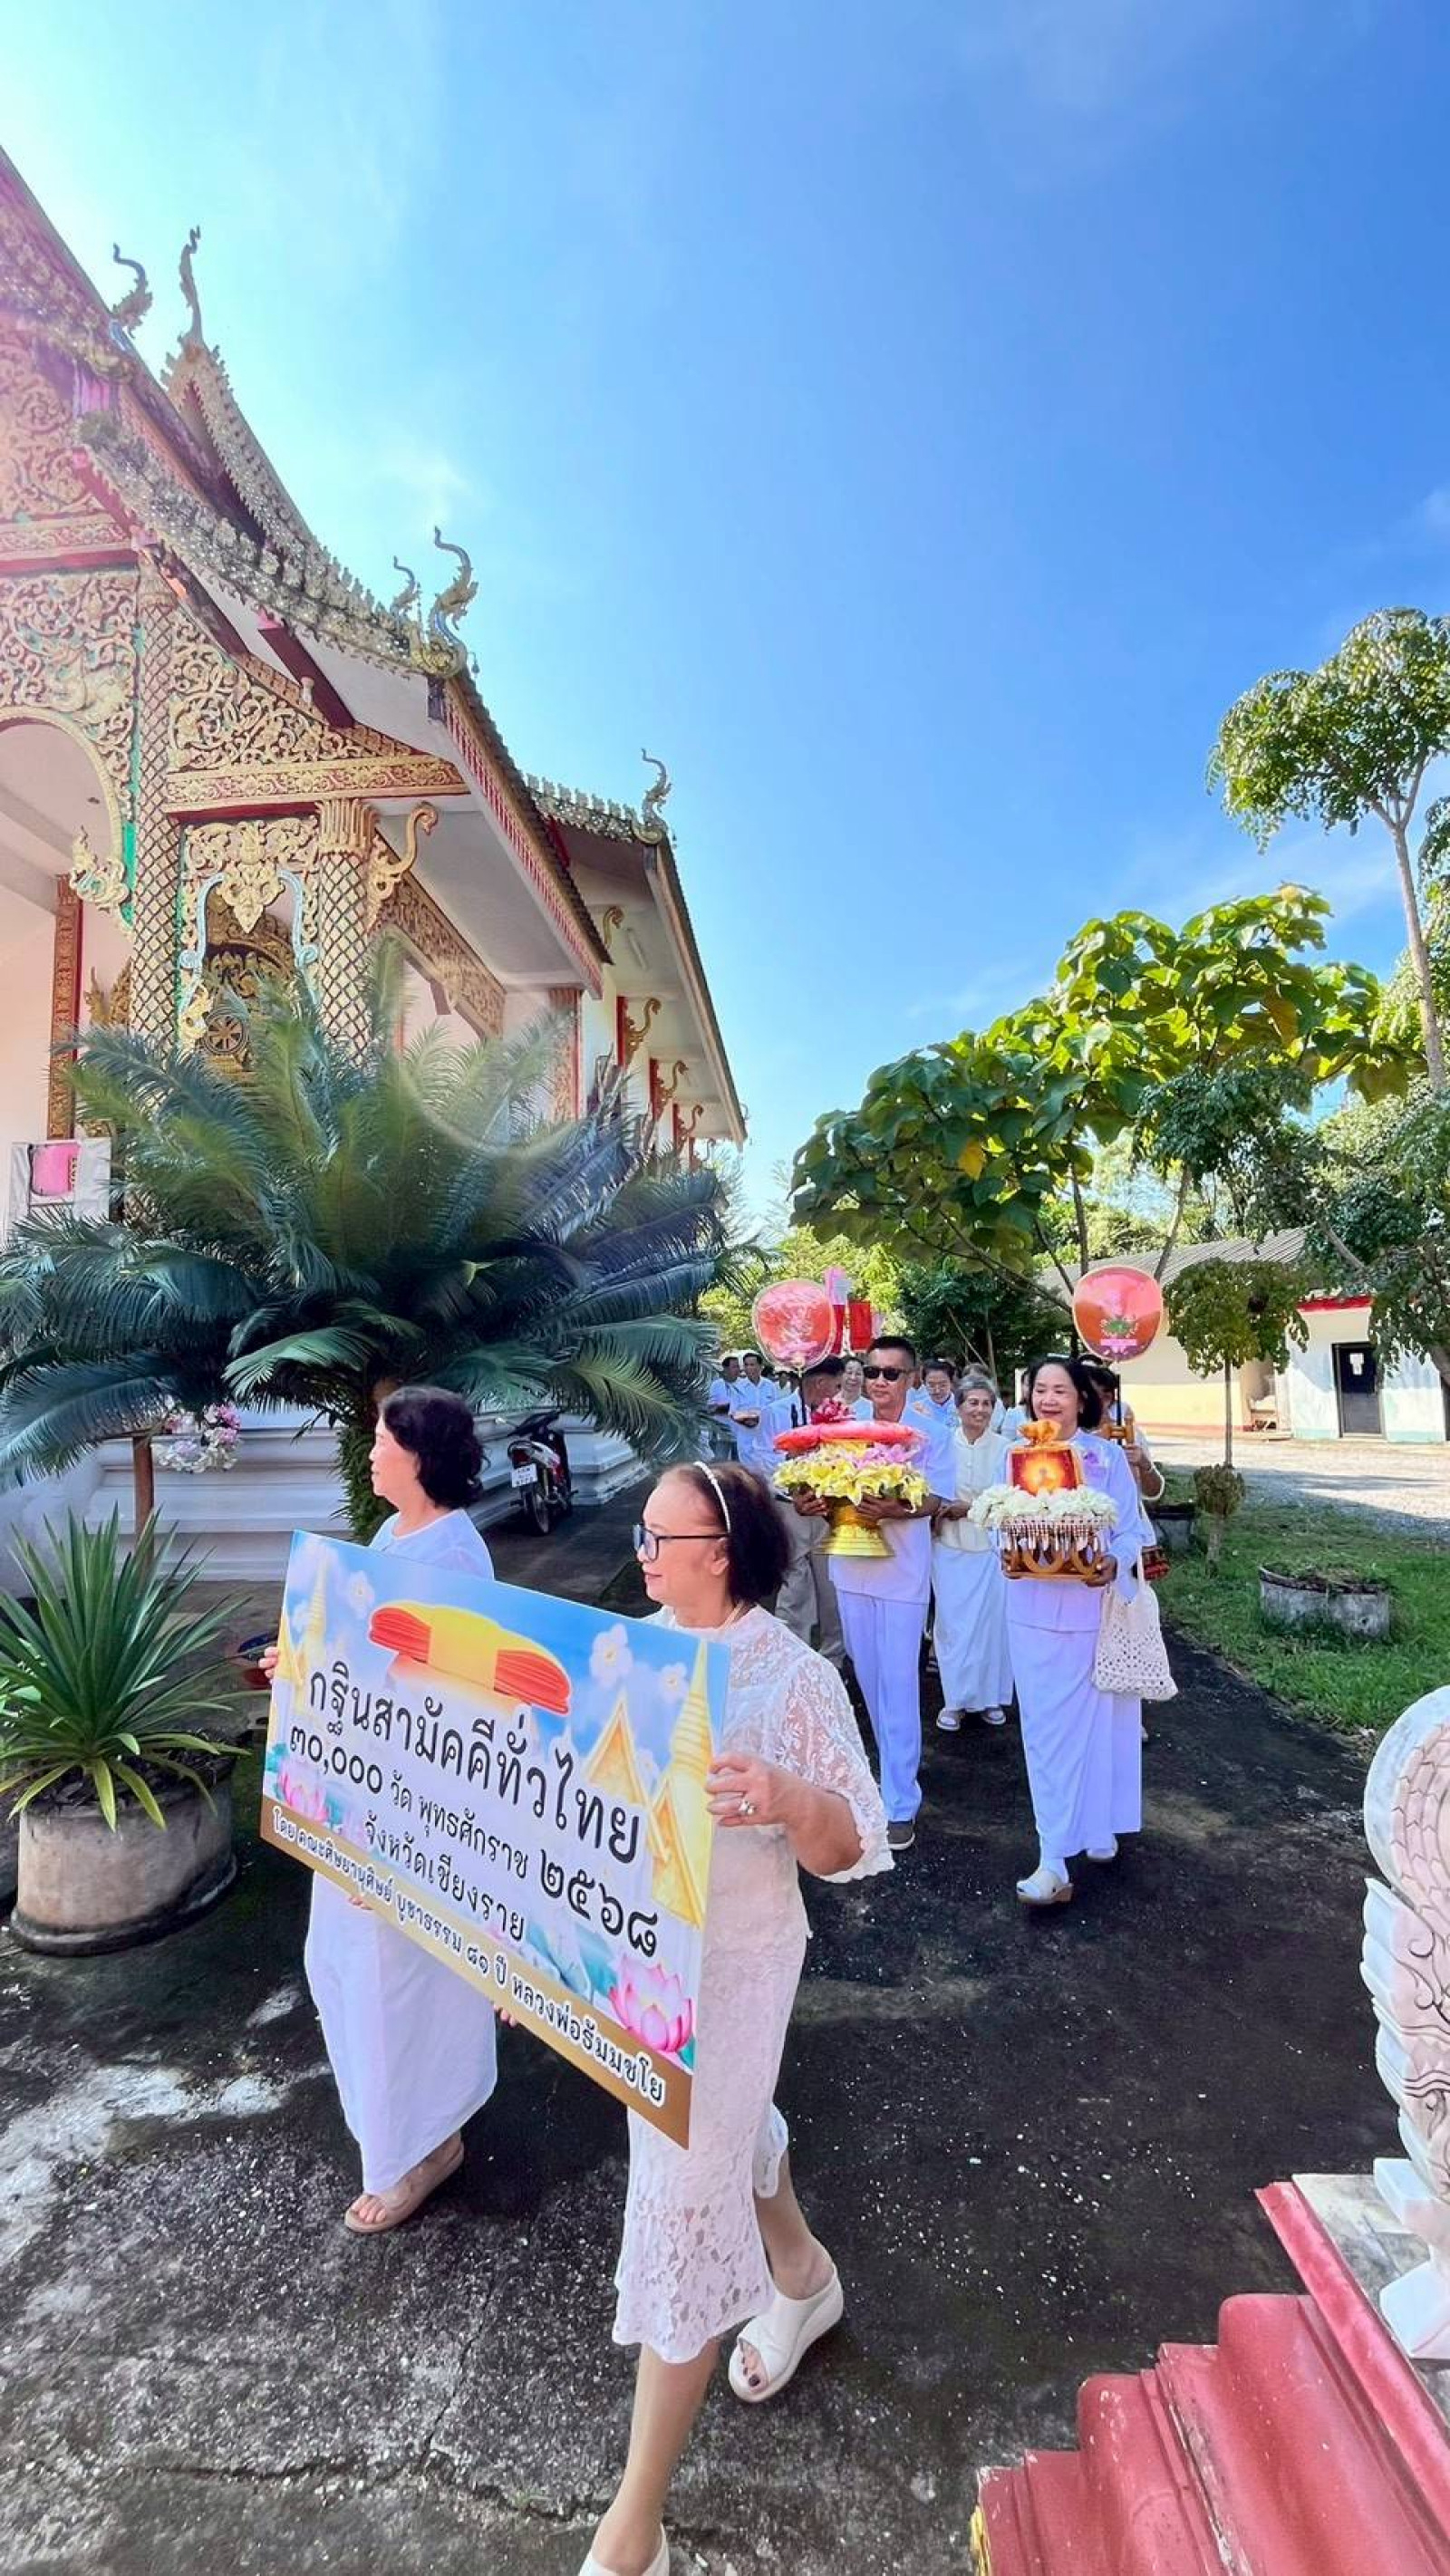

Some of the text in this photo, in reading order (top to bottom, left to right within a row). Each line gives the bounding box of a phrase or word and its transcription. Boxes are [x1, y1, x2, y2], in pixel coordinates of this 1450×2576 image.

[290, 1725, 658, 1957] ๓๐,๐๐๐ วัด พุทธศักราช ๒๕๖๘
[310, 1660, 640, 1864] กฐินสามัคคีทั่วไทย
[364, 1809, 525, 1942] จังหวัดเชียงราย
[397, 1893, 462, 1954] บูชาธรรม
[467, 1946, 489, 1974] ๘๑
[496, 1954, 508, 1985] ปี
[513, 1974, 663, 2102] หลวงพ่อธัมมชโย
